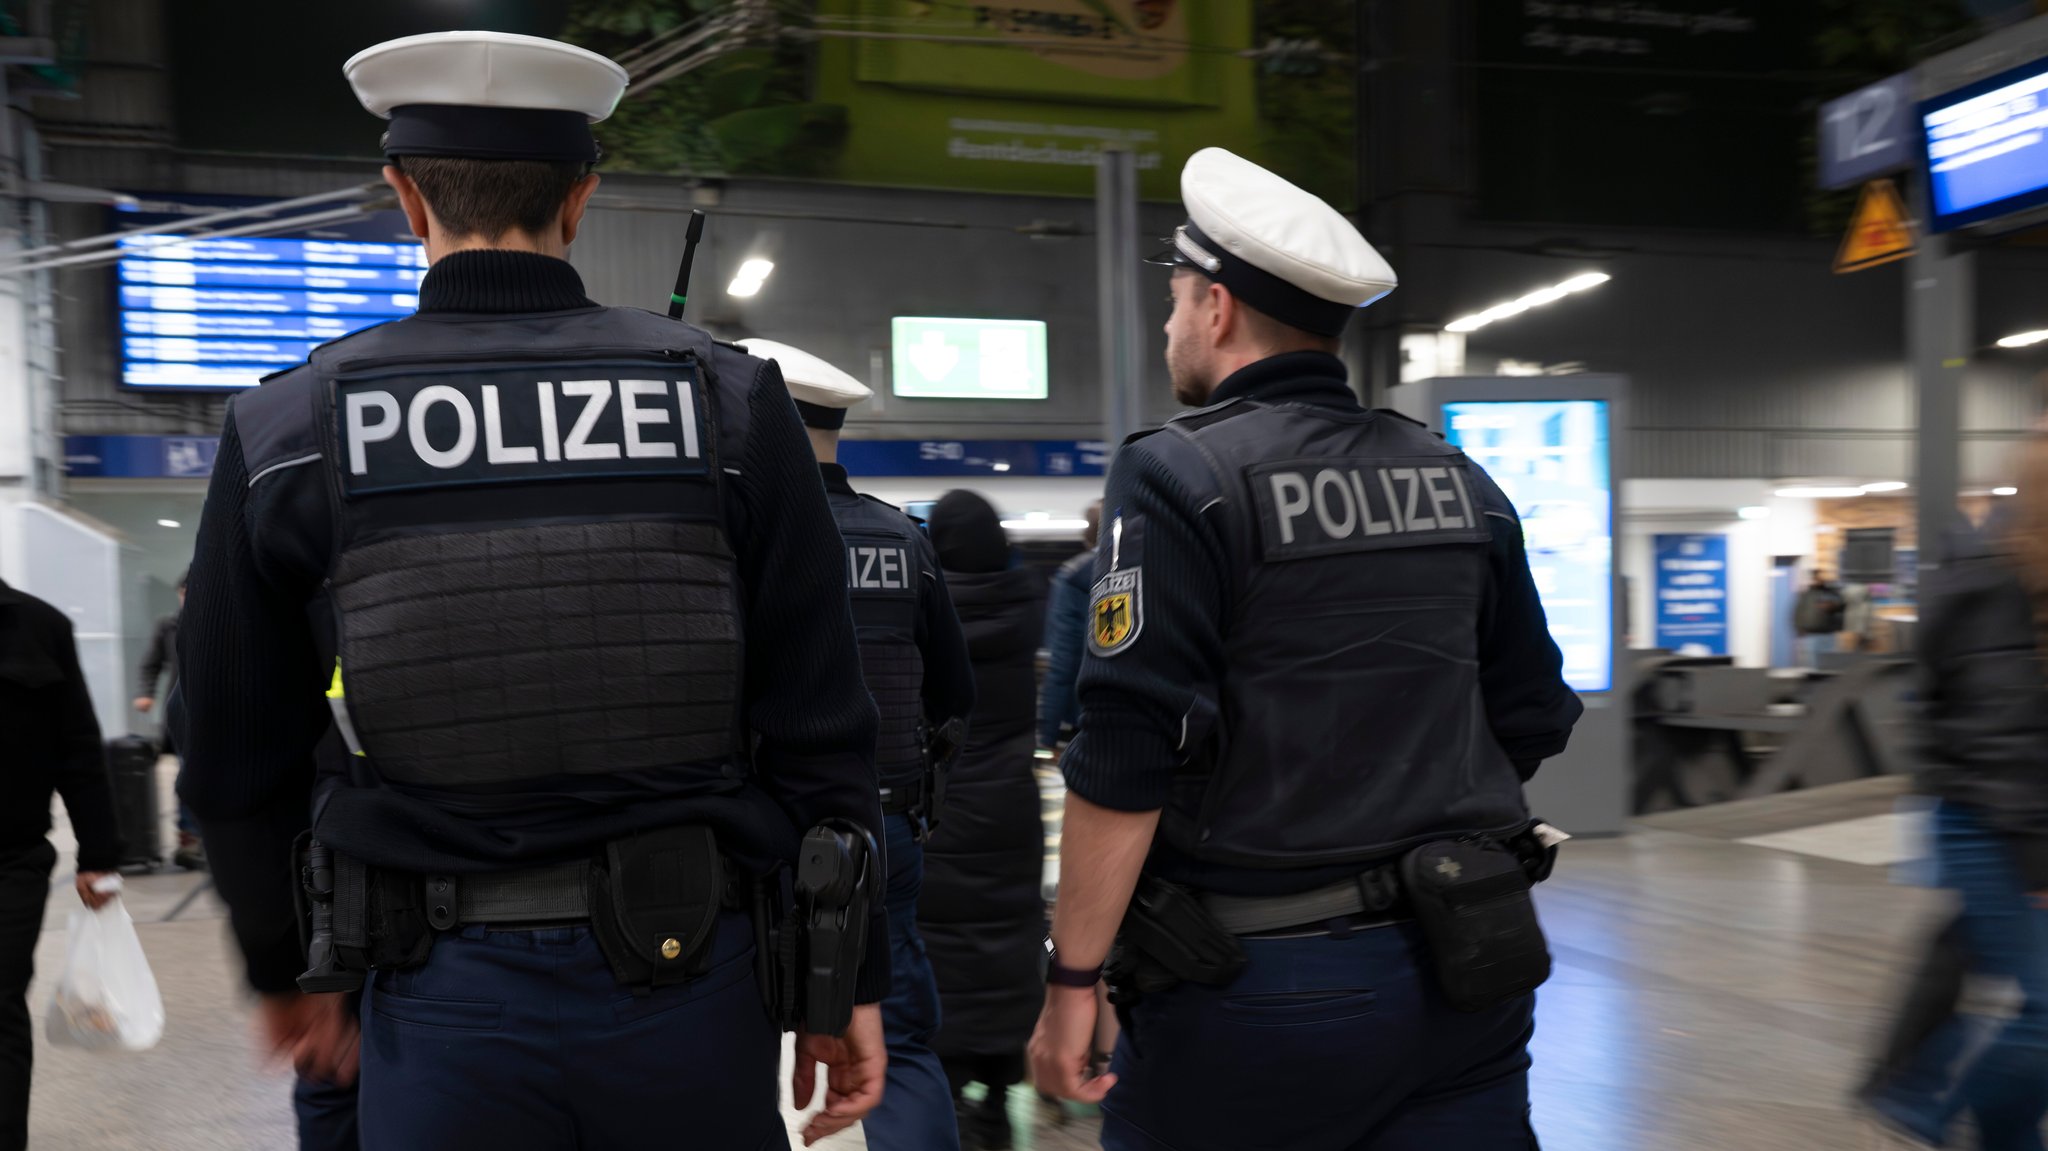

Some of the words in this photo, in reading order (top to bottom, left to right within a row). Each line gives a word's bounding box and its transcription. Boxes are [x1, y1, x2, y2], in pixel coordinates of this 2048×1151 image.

[1825, 86, 1897, 162] 12
[346, 380, 700, 475] POLIZEI
[1269, 467, 1476, 544] POLIZEI
[848, 547, 909, 588] IZEI
